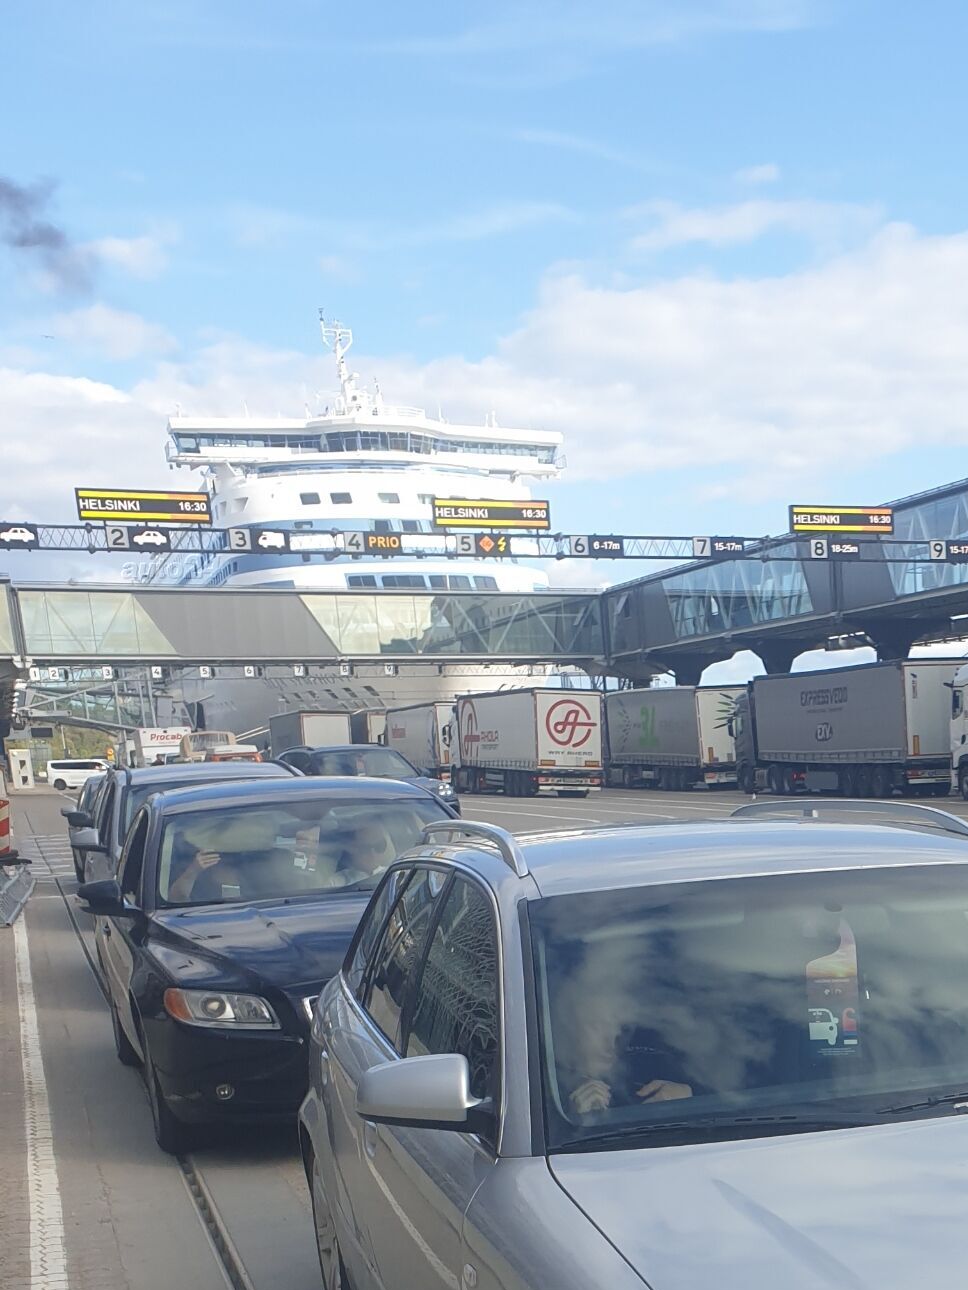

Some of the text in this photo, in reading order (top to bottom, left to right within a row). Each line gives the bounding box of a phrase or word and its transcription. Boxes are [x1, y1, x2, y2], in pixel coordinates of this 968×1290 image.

[79, 498, 207, 512] HELSINKI 16:30
[435, 507, 547, 518] HELSINKI 16:30
[793, 514, 891, 524] HELSINKI 16:30
[110, 528, 125, 546] 2
[234, 530, 247, 548] 3
[347, 532, 361, 551] 4
[368, 535, 400, 550] PRIO
[460, 536, 472, 552] 5
[574, 537, 586, 554] 6
[696, 539, 708, 555] 7
[714, 542, 743, 551] 15-17m
[814, 541, 825, 556] 8
[831, 544, 859, 553] 18-25m
[932, 542, 943, 558] 9
